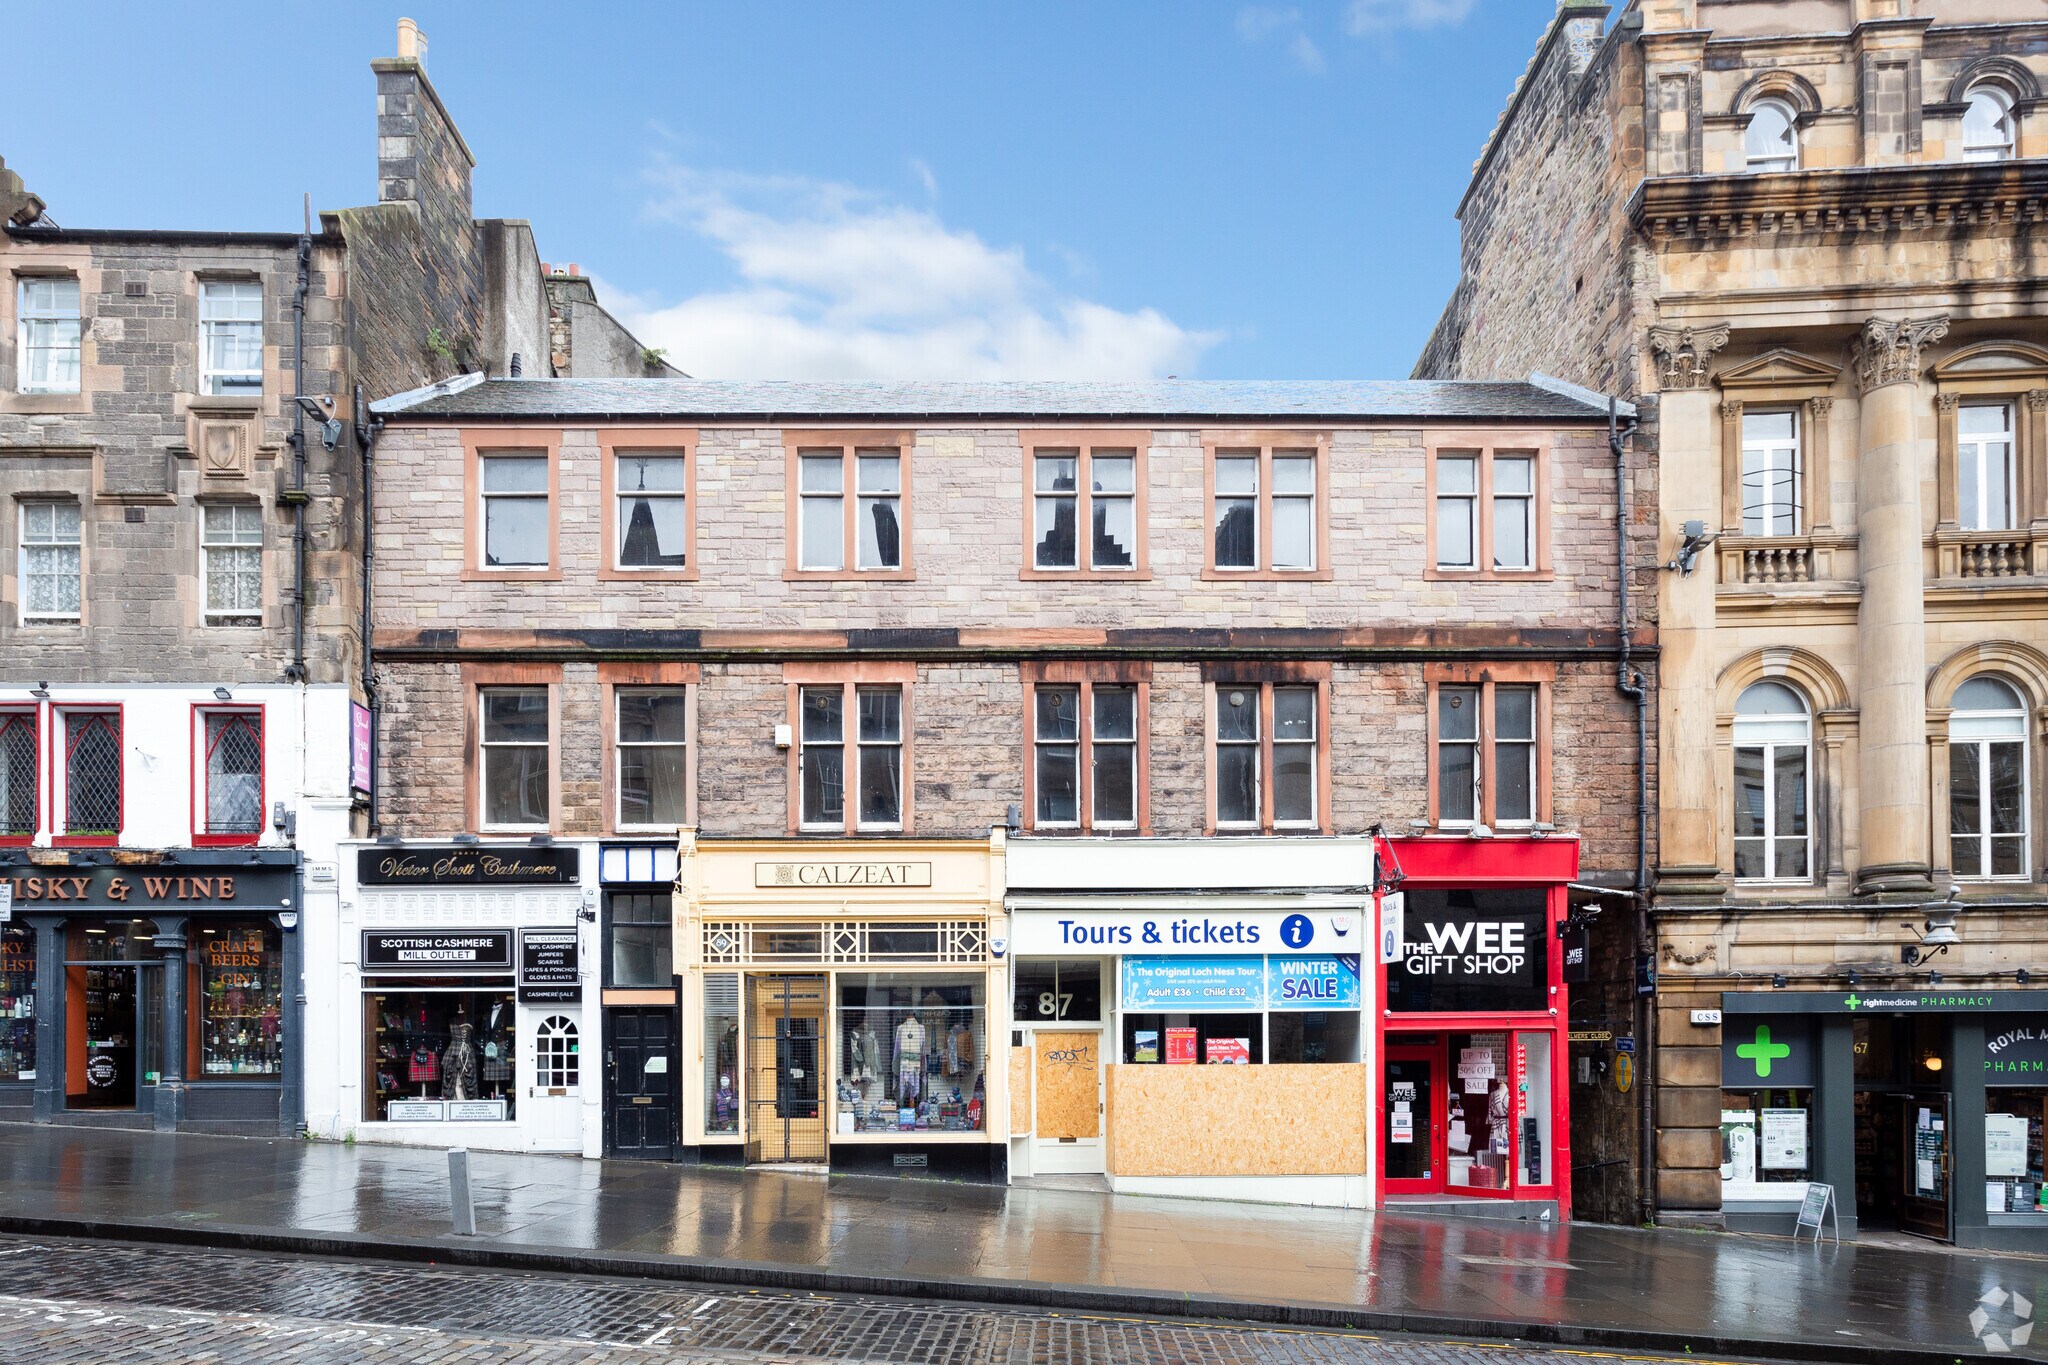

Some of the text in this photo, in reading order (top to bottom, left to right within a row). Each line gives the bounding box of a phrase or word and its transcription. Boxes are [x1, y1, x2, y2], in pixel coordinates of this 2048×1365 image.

[379, 855, 557, 880] Victor Scott Cashmere
[798, 865, 912, 884] CALZEAT
[0, 877, 236, 901] ISKY & WINE
[1058, 919, 1260, 944] Tours & tickets
[380, 938, 493, 948] SCOTTISH CASHMERE
[715, 938, 727, 948] 89
[1402, 922, 1525, 954] THE WEE
[209, 940, 262, 953] CRAFT
[403, 951, 471, 959] MILL OUTLET
[1568, 948, 1583, 958] WEE
[0, 959, 36, 971] LIST
[211, 954, 260, 967] BEERS
[1406, 956, 1525, 975] GIFT SHOP
[1137, 967, 1257, 978] The Original Loch Ness Tour
[1280, 961, 1338, 975] WINTER
[220, 972, 251, 985] GIN
[1147, 988, 1246, 997] Adult £36 Child £32
[1282, 978, 1338, 999] SALE
[1038, 991, 1073, 1017] 87
[1863, 997, 1993, 1008] rightmedicine PHARMACY
[1987, 1028, 2034, 1054] ROYAL
[1853, 1042, 1868, 1054] 67
[1462, 1051, 1490, 1060] UP TO
[1459, 1066, 1493, 1074] 50% OFF
[1984, 1061, 2048, 1072] PHARM
[1466, 1082, 1488, 1090] SALE
[1393, 1089, 1417, 1097] WEE
